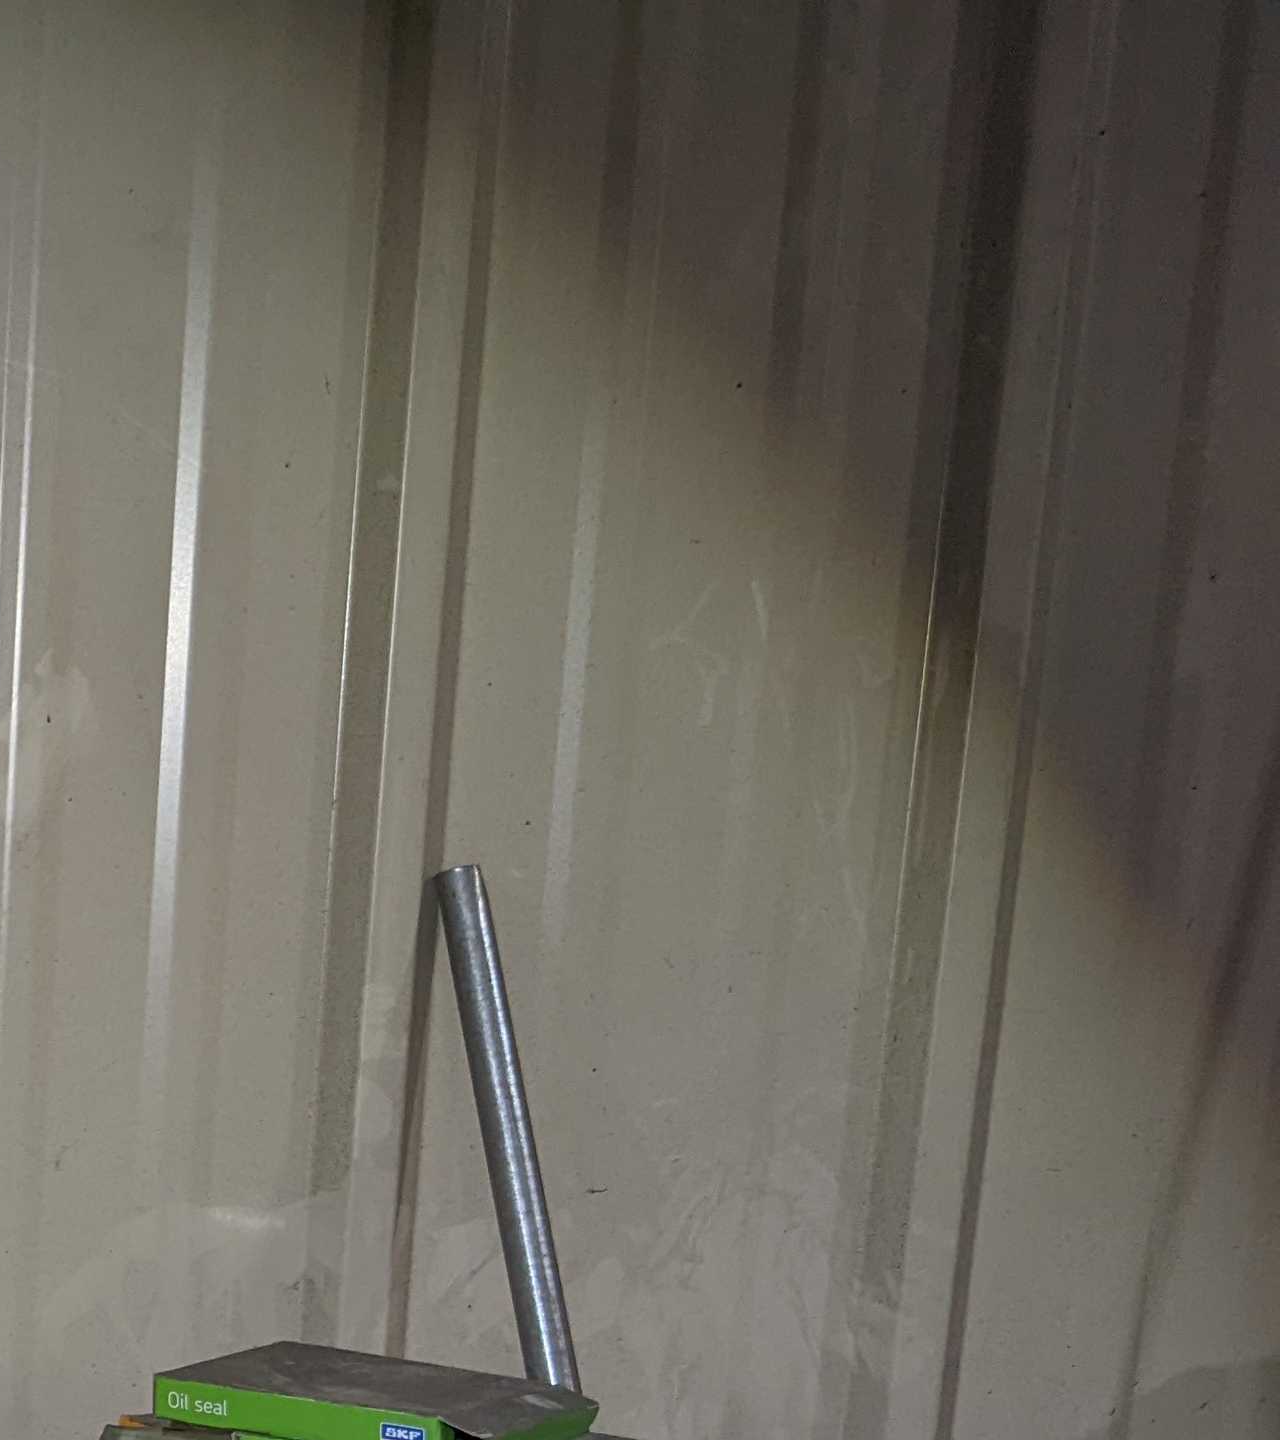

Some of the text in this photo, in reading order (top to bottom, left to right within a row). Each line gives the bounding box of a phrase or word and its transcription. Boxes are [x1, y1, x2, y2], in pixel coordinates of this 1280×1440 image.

[168, 1391, 227, 1416] Oil seal
[385, 1427, 421, 1440] SKF
